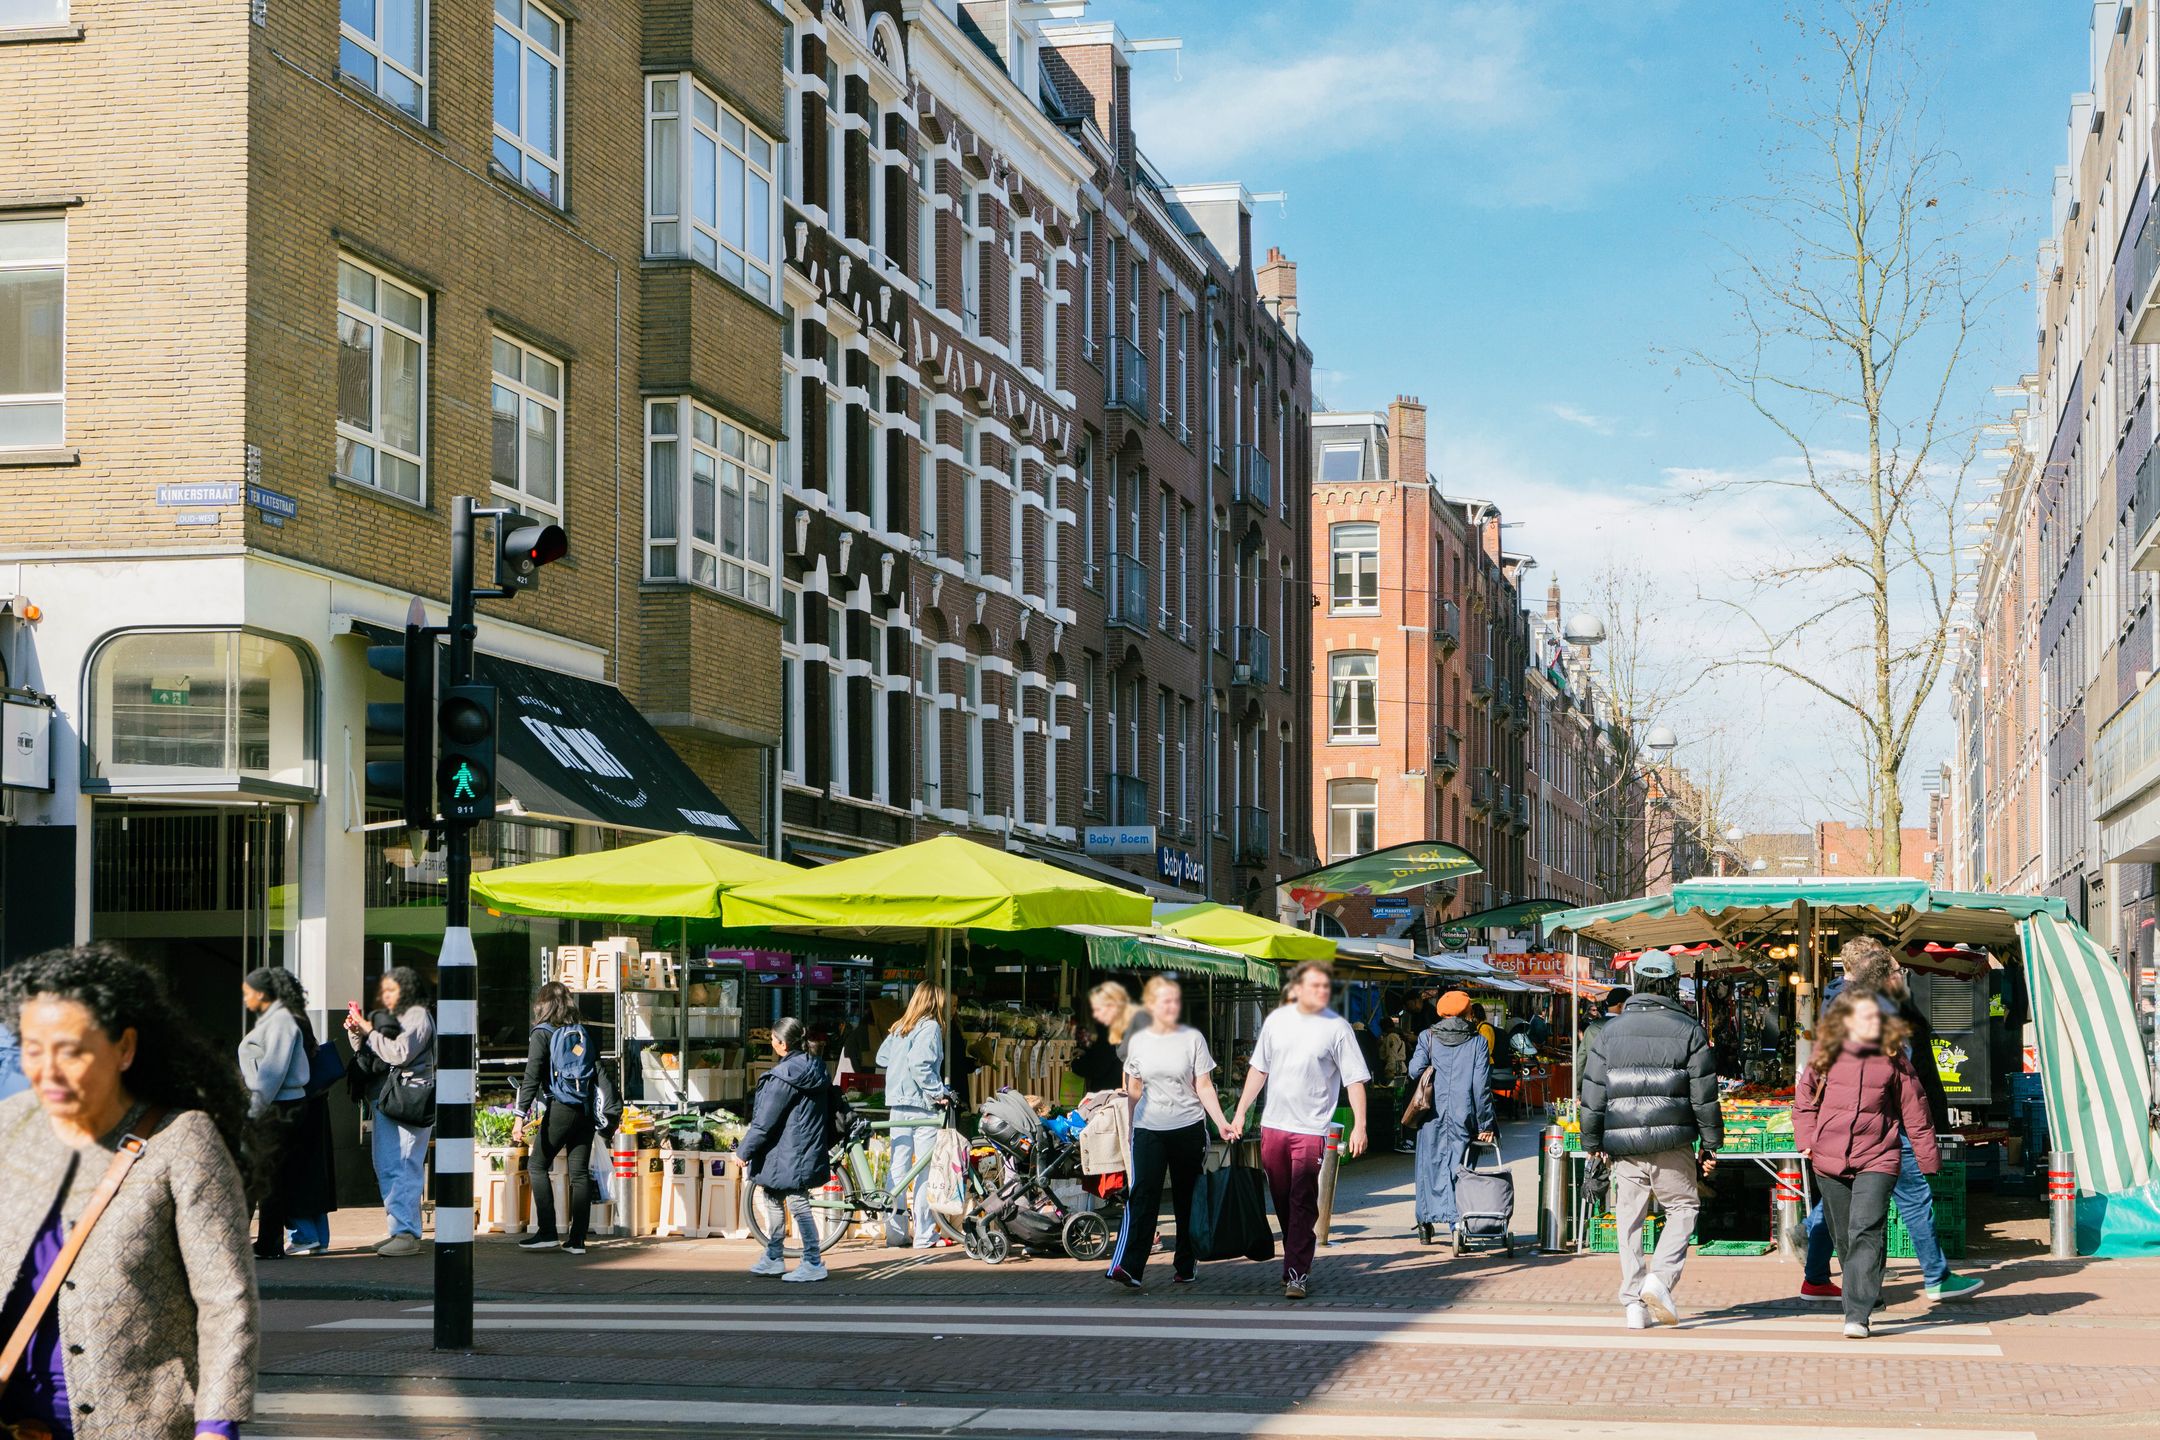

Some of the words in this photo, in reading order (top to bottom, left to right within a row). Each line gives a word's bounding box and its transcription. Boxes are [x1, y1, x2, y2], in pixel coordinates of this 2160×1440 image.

[161, 488, 234, 501] KINKERSTRAAT
[251, 490, 260, 505] TEN
[262, 493, 295, 514] KATESTRAAT
[179, 514, 216, 523] OUD-WEST
[516, 575, 528, 584] 421
[1089, 834, 1116, 846] Baby
[1121, 834, 1149, 844] Boem
[1163, 846, 1182, 887] Baby
[1184, 852, 1204, 884] Boem
[1441, 931, 1467, 939] Heineken
[1488, 958, 1525, 971] Fresh
[1529, 957, 1562, 971] Fruit
[1930, 1039, 1951, 1048] EERT
